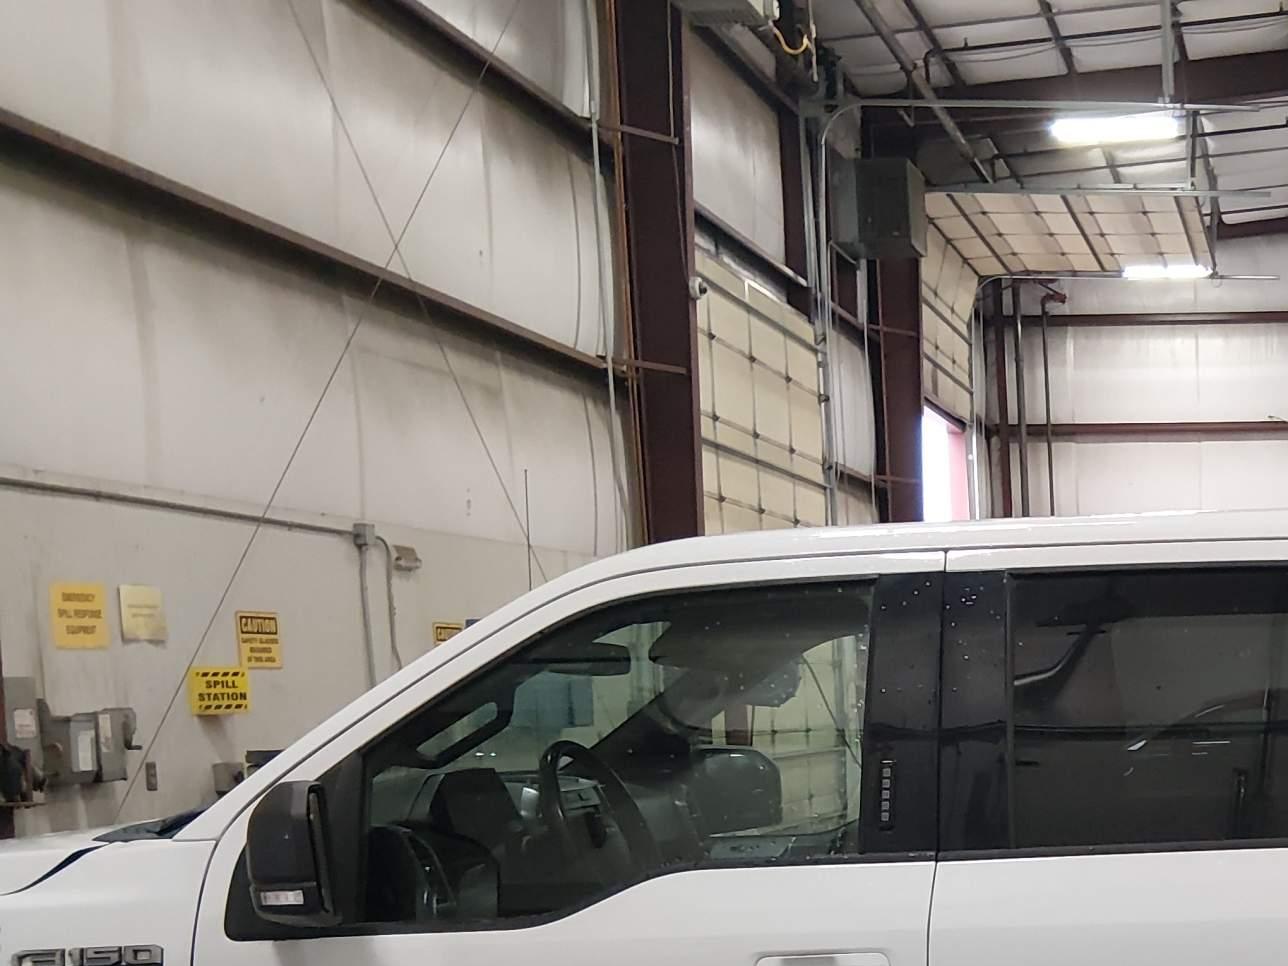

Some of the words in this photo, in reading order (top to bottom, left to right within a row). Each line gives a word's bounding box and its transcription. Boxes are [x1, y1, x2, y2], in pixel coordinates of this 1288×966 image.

[241, 617, 277, 633] CAUTION
[205, 680, 238, 689] SPILL
[198, 692, 247, 701] STATION
